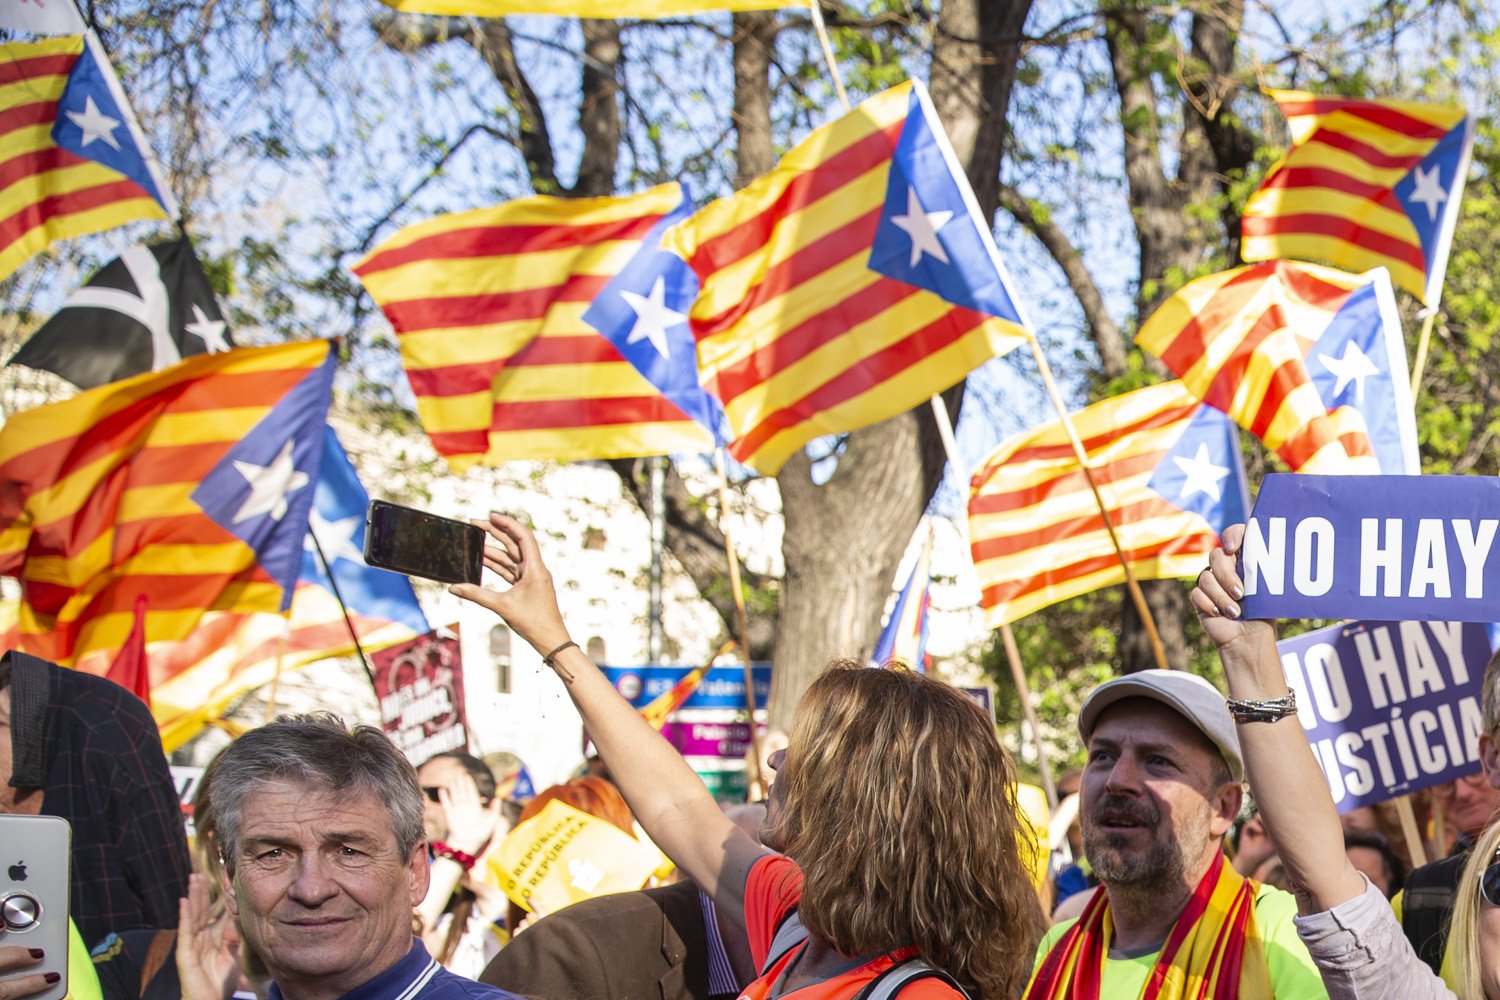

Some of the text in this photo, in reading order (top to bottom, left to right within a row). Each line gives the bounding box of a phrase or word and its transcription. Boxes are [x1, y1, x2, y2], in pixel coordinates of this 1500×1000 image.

[1243, 516, 1335, 597] NO
[1359, 518, 1500, 599] HAY
[1354, 620, 1470, 710] HAY
[1310, 696, 1483, 805] USTÍCIA
